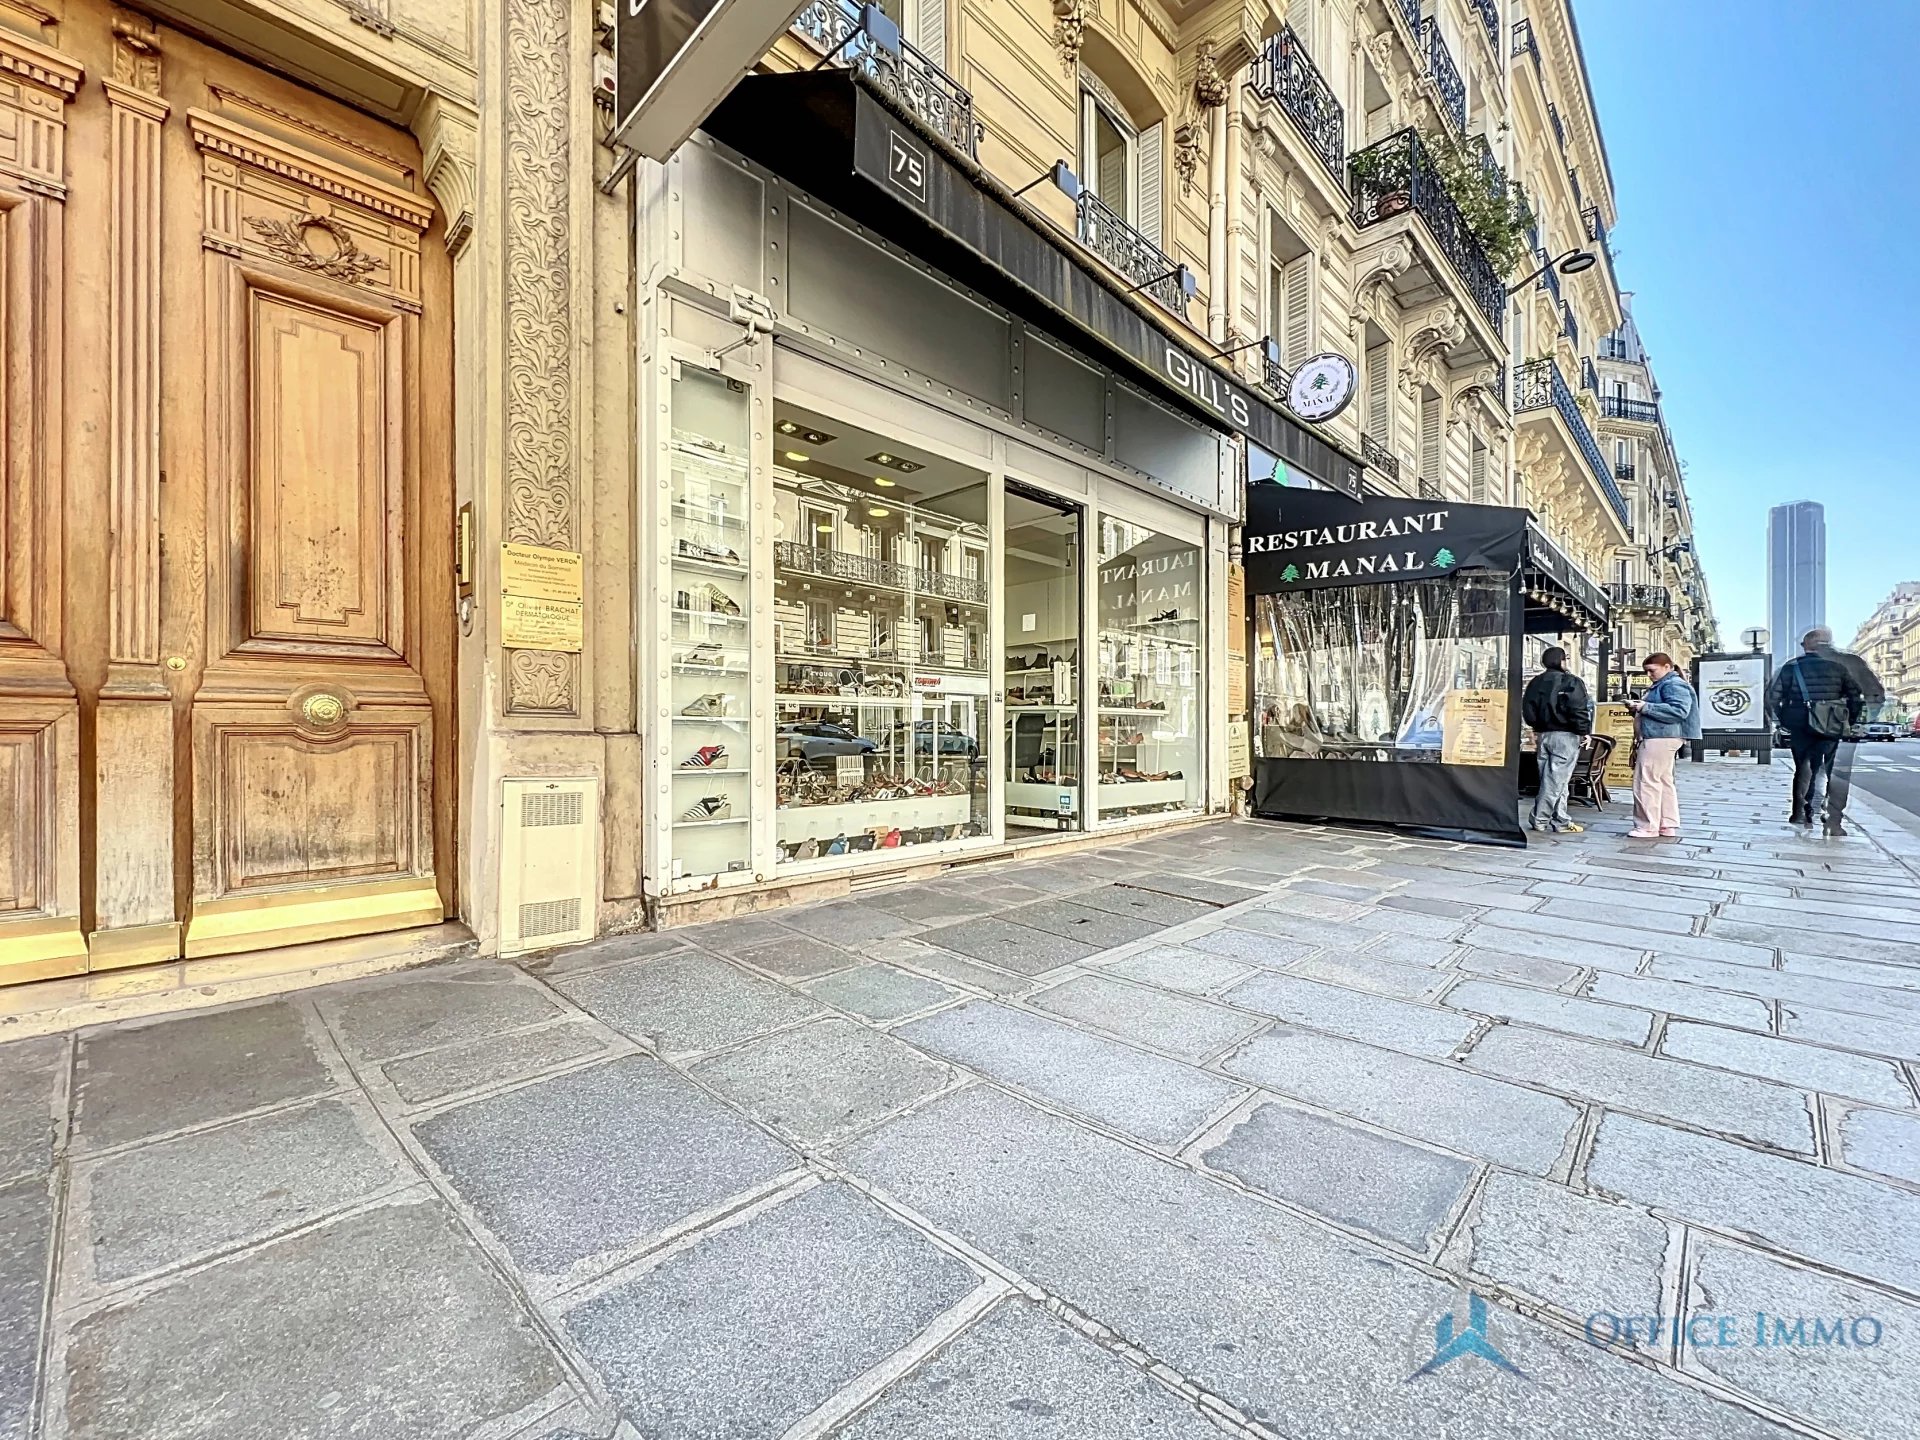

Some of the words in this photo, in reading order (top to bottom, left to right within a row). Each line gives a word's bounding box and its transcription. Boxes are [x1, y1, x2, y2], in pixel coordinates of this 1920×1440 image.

[893, 145, 923, 187] 75
[1166, 348, 1249, 428] GILL'S
[1248, 511, 1449, 554] RESTAURANT
[507, 550, 531, 558] Docteur
[532, 553, 555, 562] Olympe
[556, 557, 578, 565] VERON
[1305, 551, 1424, 580] MANAL
[545, 605, 579, 614] BRACHAT
